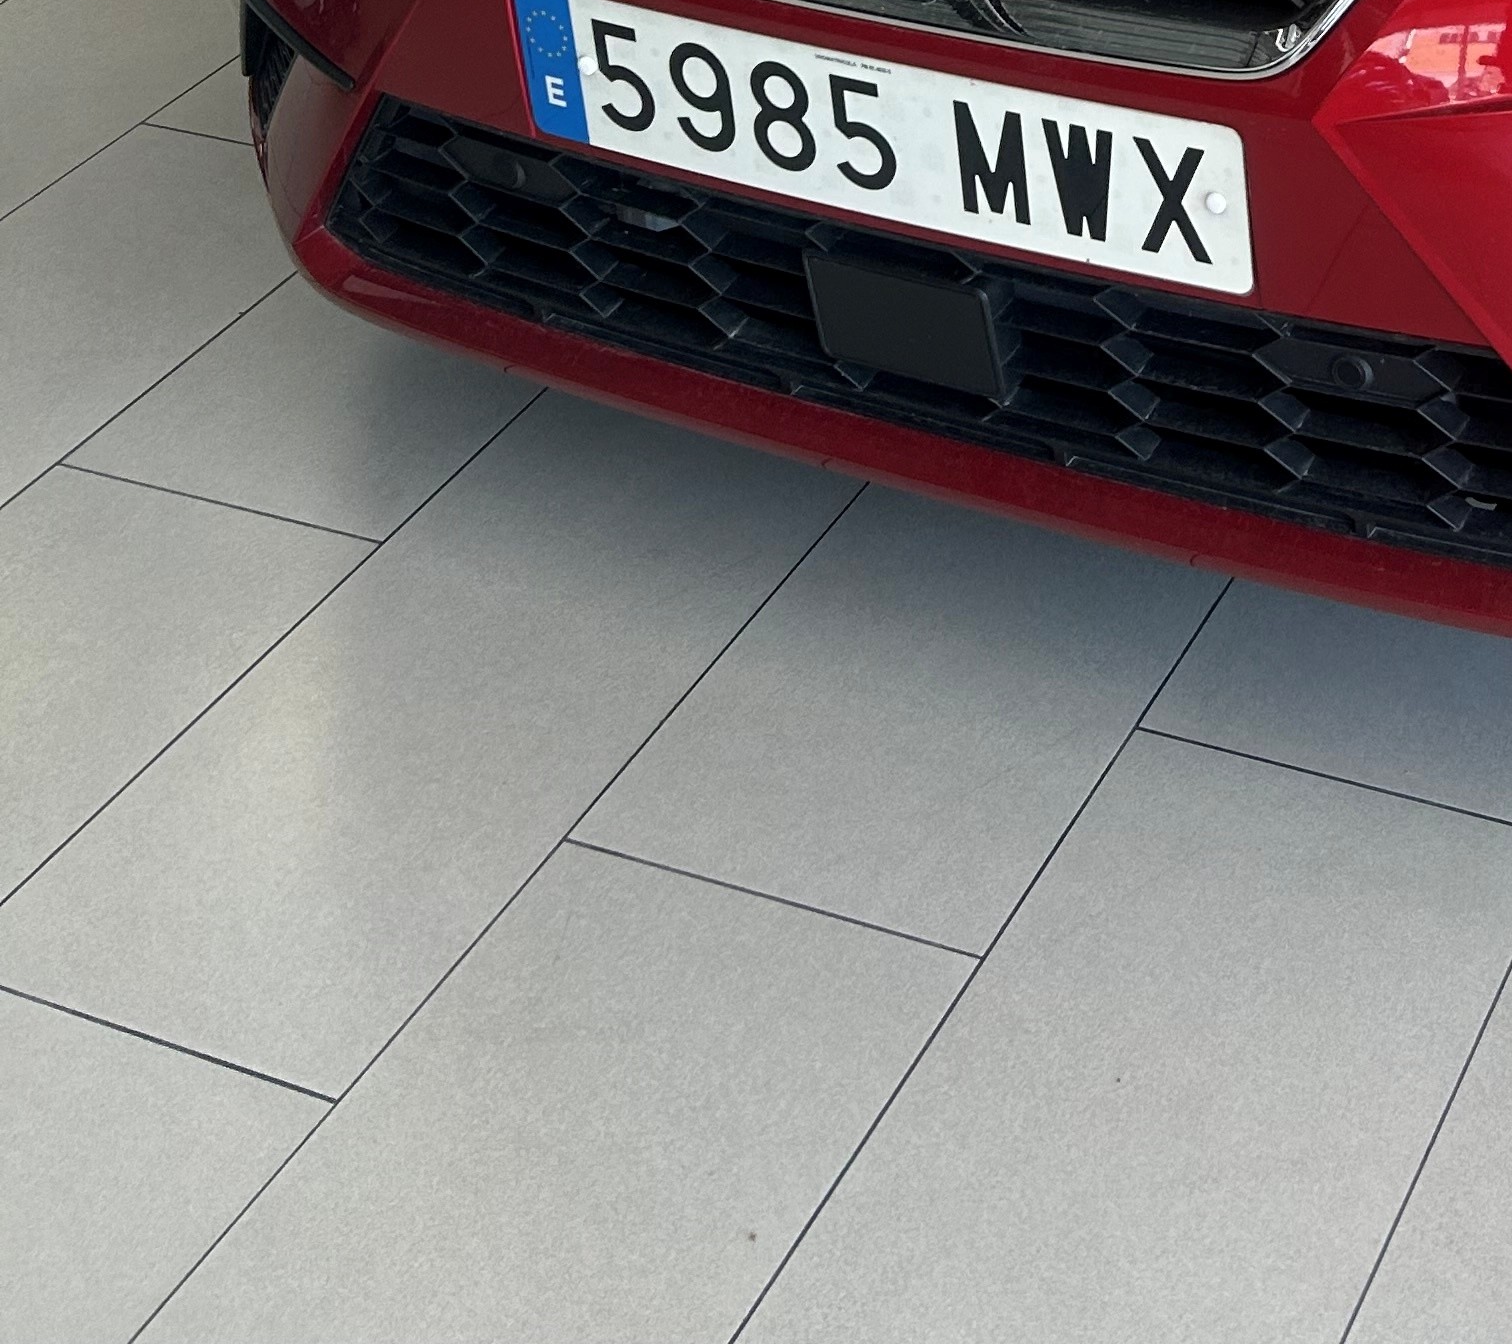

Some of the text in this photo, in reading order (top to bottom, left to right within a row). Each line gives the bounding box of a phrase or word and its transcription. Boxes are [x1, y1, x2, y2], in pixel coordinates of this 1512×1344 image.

[545, 75, 568, 108] E
[591, 18, 1213, 264] 5985 MWX
